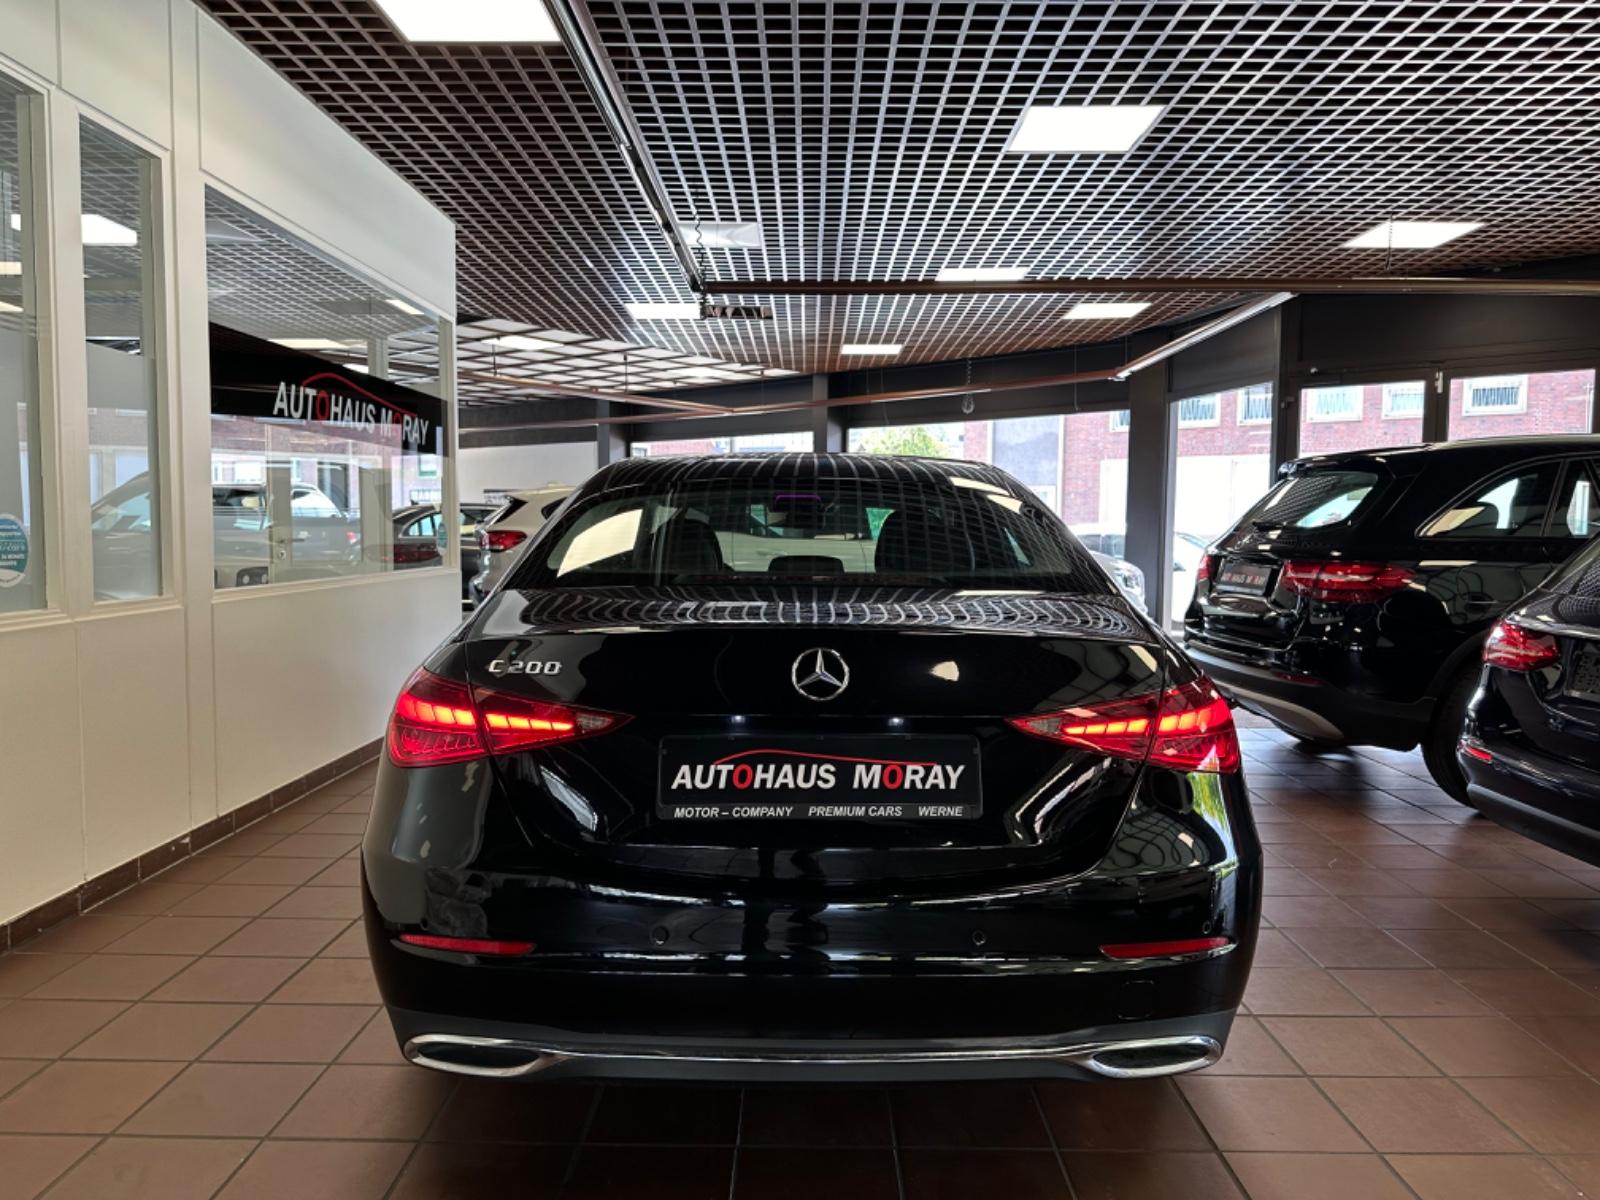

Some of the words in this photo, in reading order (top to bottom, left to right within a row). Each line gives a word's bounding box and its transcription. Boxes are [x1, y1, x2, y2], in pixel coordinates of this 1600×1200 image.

[273, 381, 377, 434] AUTOHAUS
[380, 407, 429, 446] MORAY
[488, 659, 505, 673] C
[507, 660, 562, 676] 200
[671, 763, 837, 791] AUTOHAUS
[852, 763, 966, 791] MORAY
[674, 806, 720, 818] MOTOR
[732, 805, 794, 818] COMPANY
[808, 805, 866, 817] PREMIUM
[868, 805, 903, 817] CARS
[918, 805, 964, 817] WERNE
